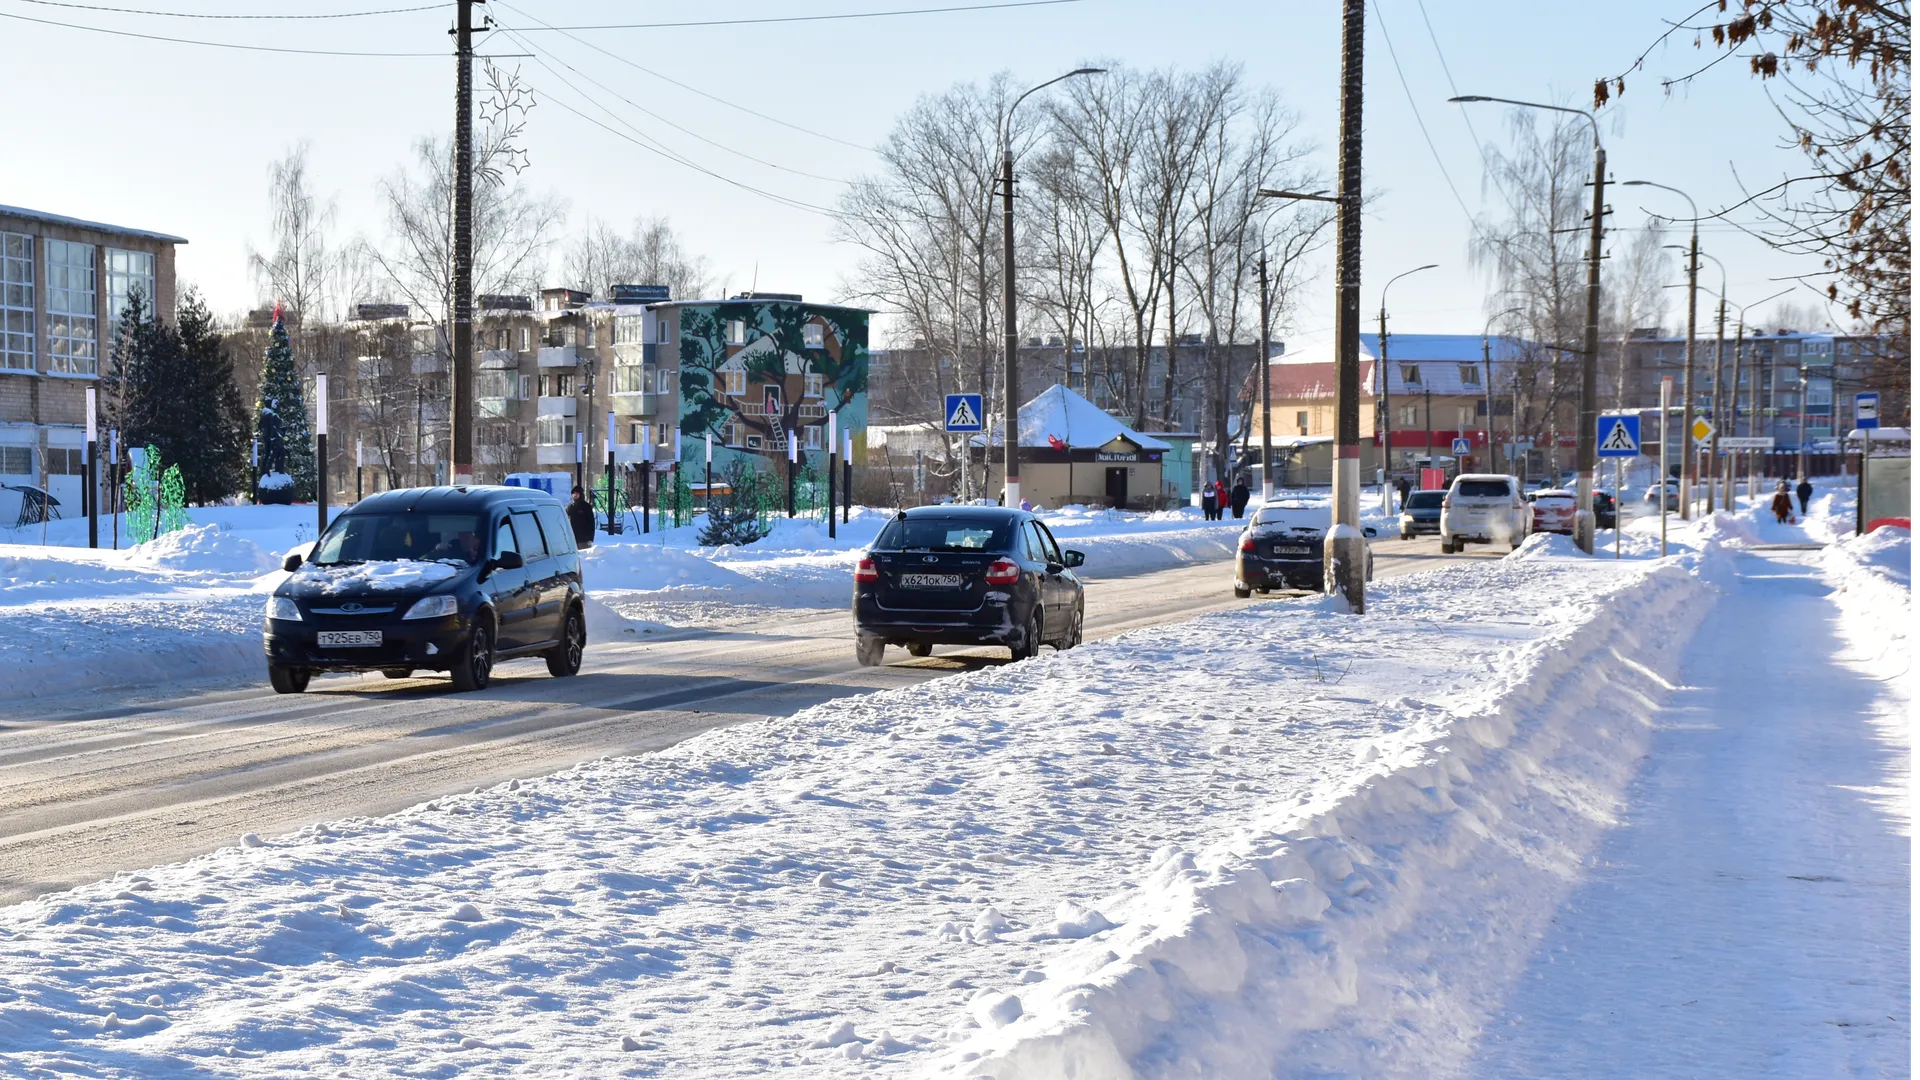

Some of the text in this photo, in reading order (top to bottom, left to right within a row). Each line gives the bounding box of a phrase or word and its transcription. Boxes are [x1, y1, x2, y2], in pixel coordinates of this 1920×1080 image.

[904, 575, 940, 585] Х621ОК
[321, 632, 380, 644] Т925ЕВ 750
